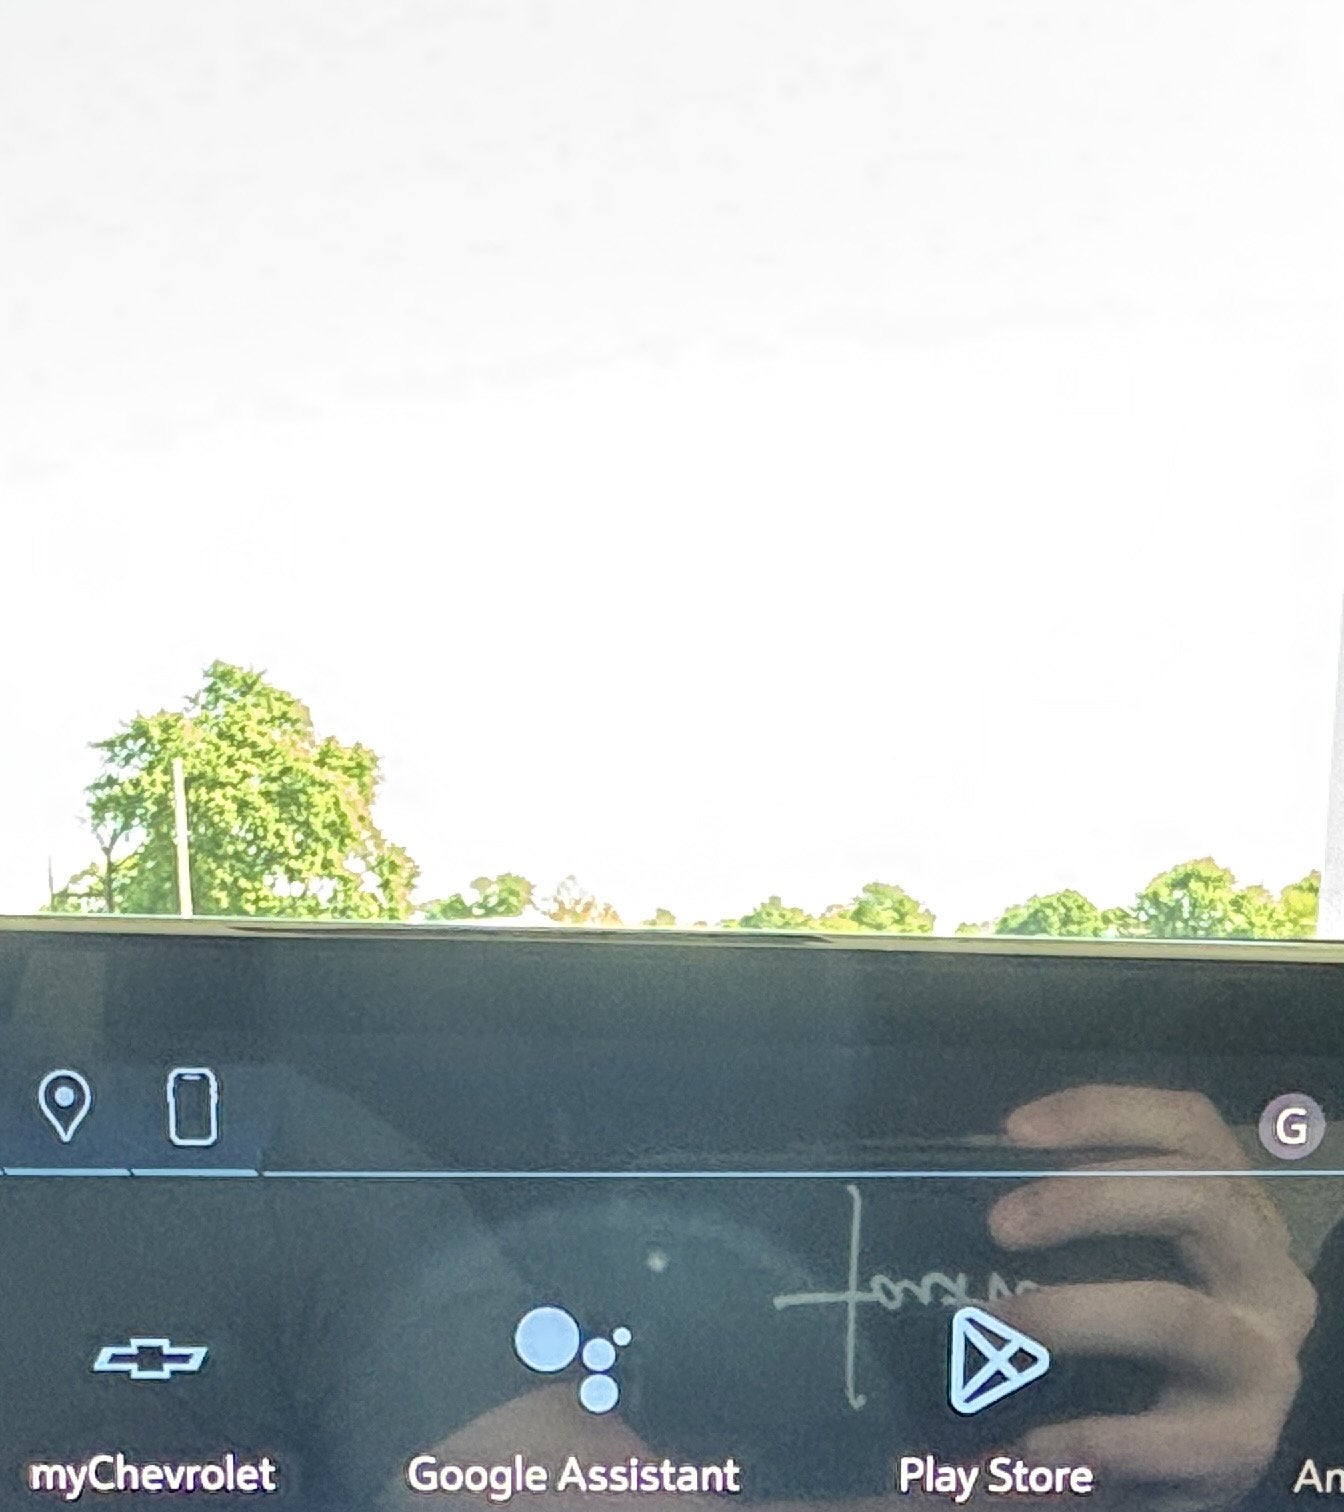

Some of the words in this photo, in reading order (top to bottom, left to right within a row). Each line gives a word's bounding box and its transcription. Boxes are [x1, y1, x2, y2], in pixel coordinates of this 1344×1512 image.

[1275, 1105, 1309, 1146] G
[29, 1451, 279, 1502] myChevrolet
[407, 1452, 549, 1503] Google
[556, 1455, 741, 1493] Assistant
[899, 1453, 981, 1504] Play
[987, 1455, 1095, 1495] Store
